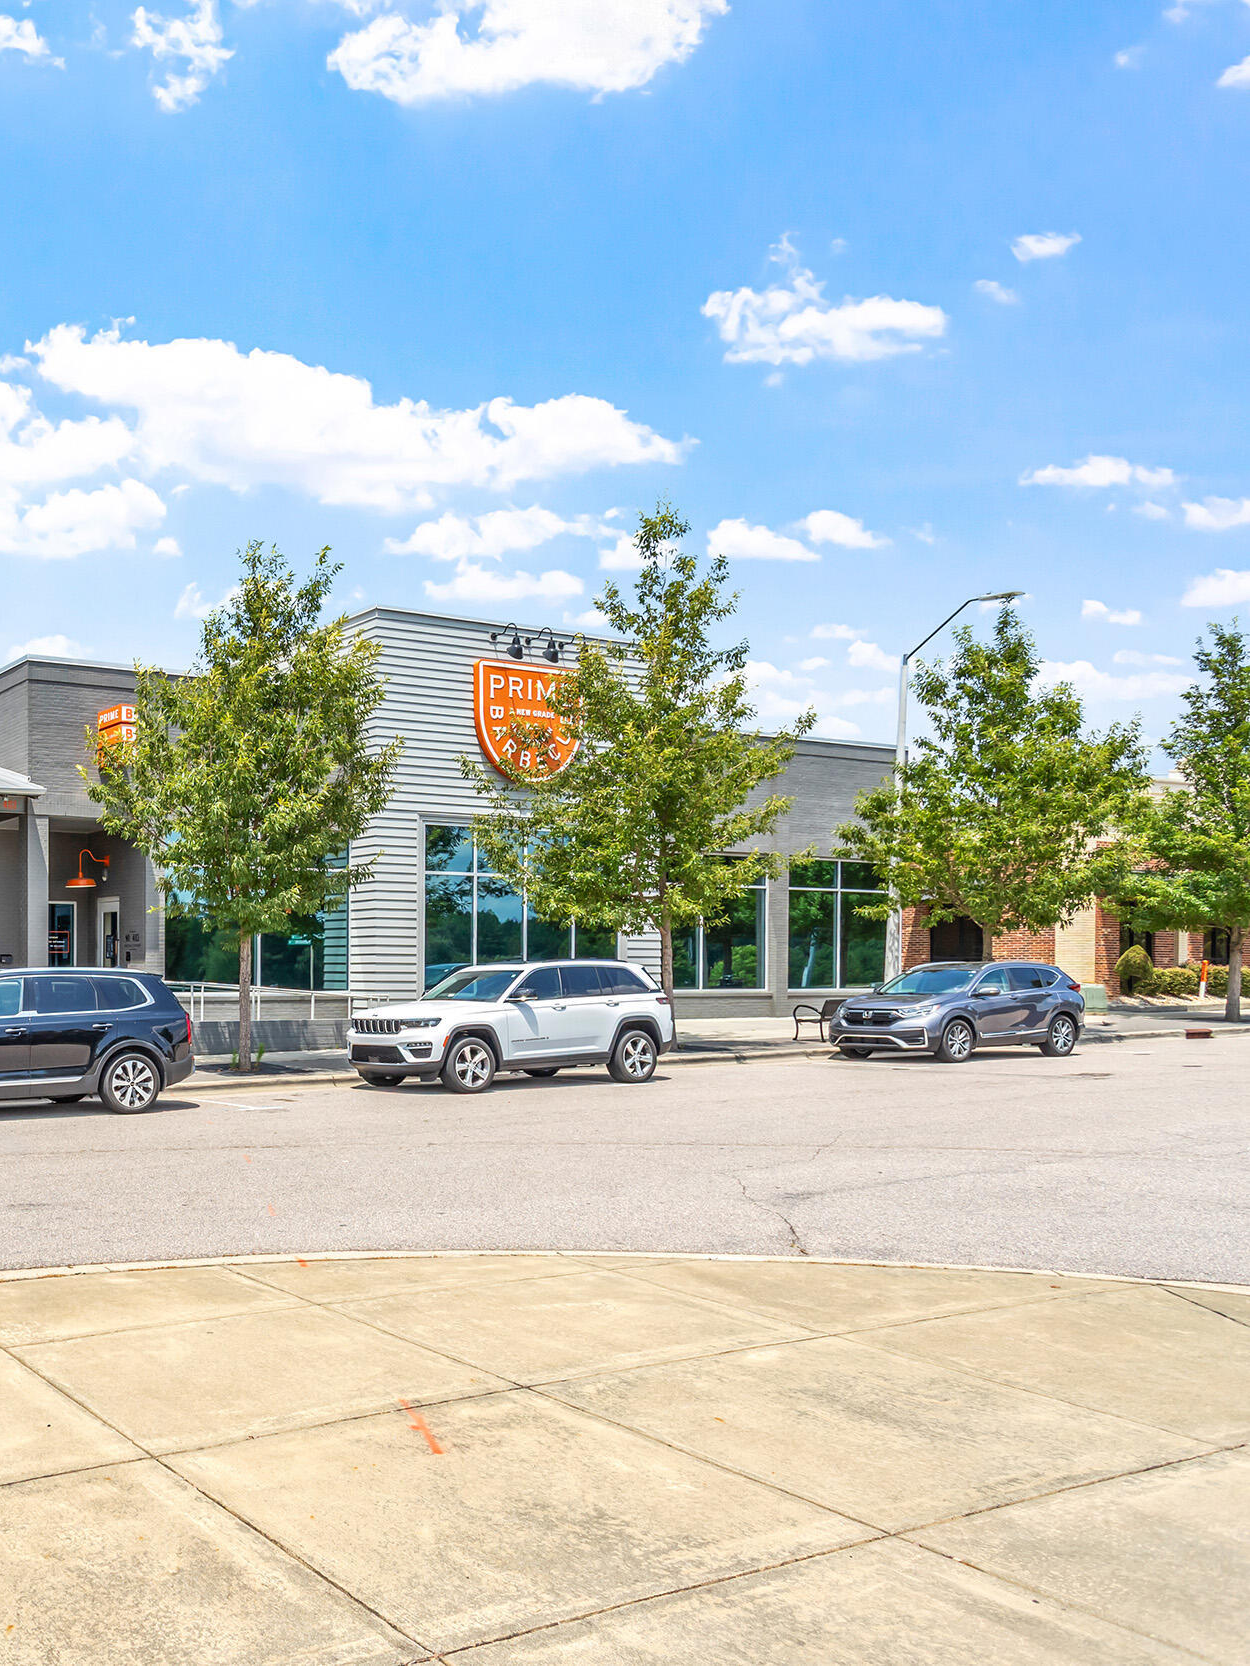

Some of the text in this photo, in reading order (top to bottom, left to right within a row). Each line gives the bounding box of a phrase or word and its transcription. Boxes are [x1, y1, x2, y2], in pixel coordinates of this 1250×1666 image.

[489, 674, 570, 706] PRIM
[99, 709, 119, 724] PRIME
[516, 708, 531, 716] NEW
[532, 710, 555, 719] GRADE
